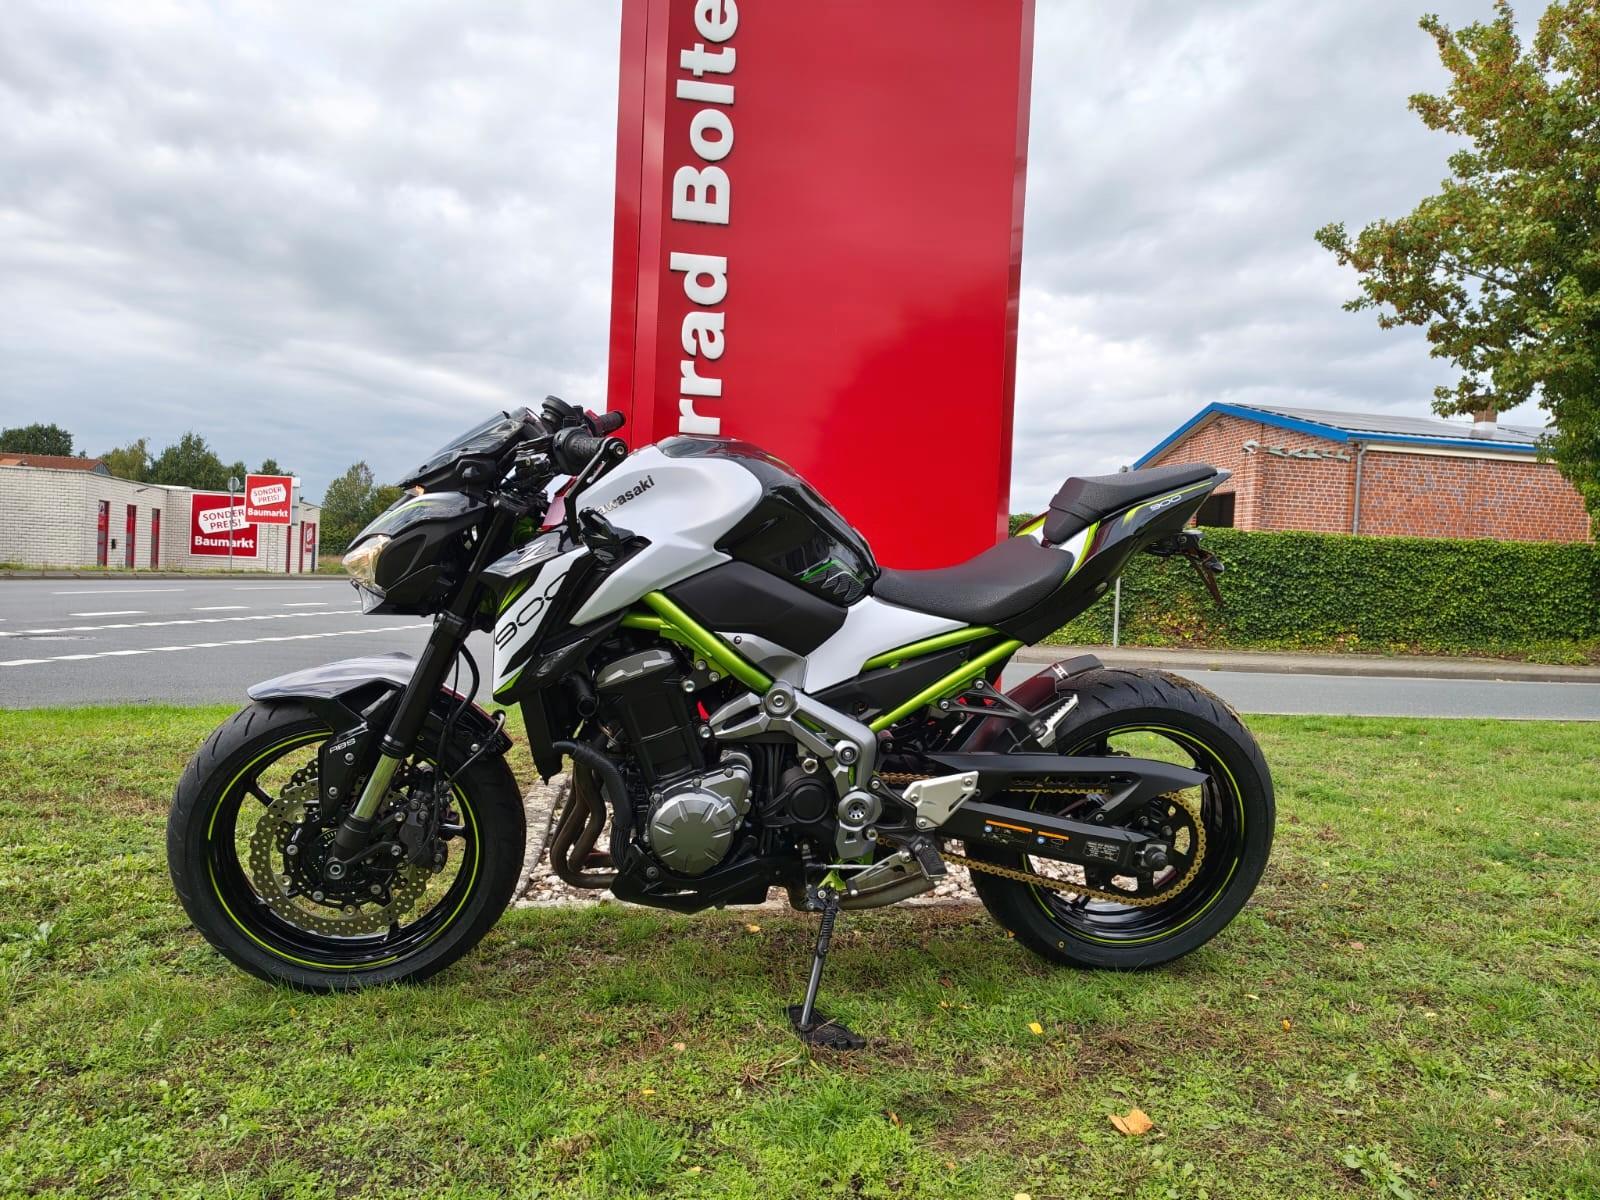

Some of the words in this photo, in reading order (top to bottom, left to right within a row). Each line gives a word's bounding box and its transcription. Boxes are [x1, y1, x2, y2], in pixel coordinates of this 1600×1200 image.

[672, 0, 739, 225] Bolte
[253, 487, 281, 497] SONDER
[593, 474, 655, 514] awasaki
[1150, 495, 1182, 511] 900
[202, 508, 245, 521] SONDER
[248, 507, 288, 517] Baumarkt
[195, 536, 254, 548] Baumarkt
[330, 738, 356, 754] ABS
